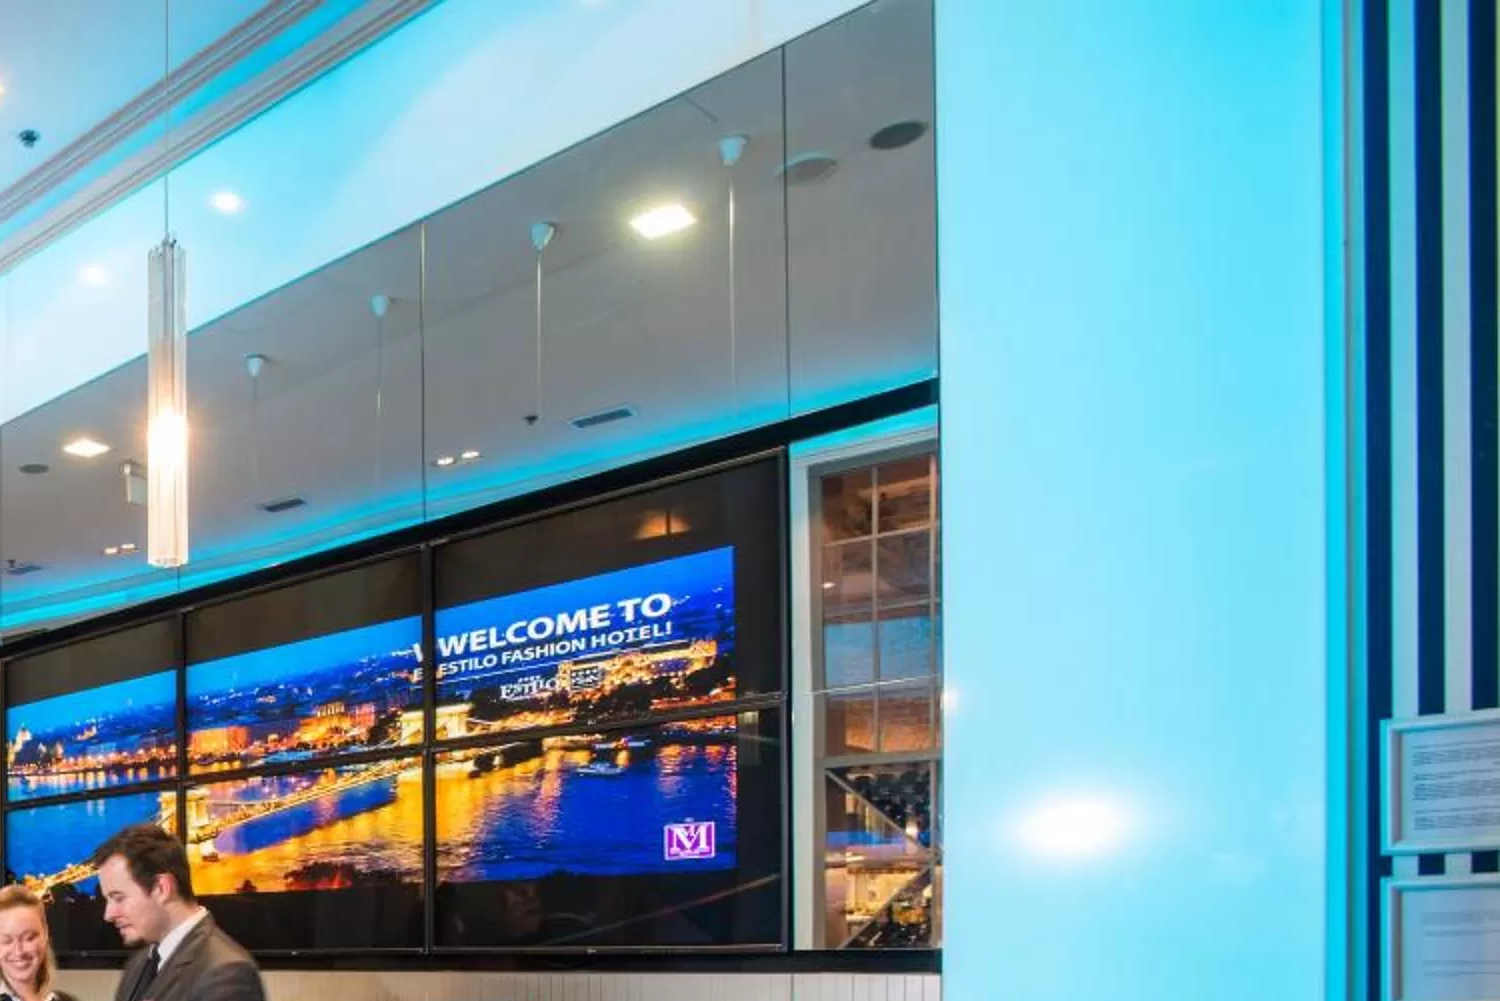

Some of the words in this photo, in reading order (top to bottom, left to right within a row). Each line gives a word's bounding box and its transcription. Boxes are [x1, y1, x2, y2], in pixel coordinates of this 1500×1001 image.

[438, 602, 611, 657] WELCOME
[617, 592, 671, 623] TO
[440, 653, 497, 676] ESTILO
[501, 637, 585, 665] FASHION
[591, 620, 672, 648] HOTEL!
